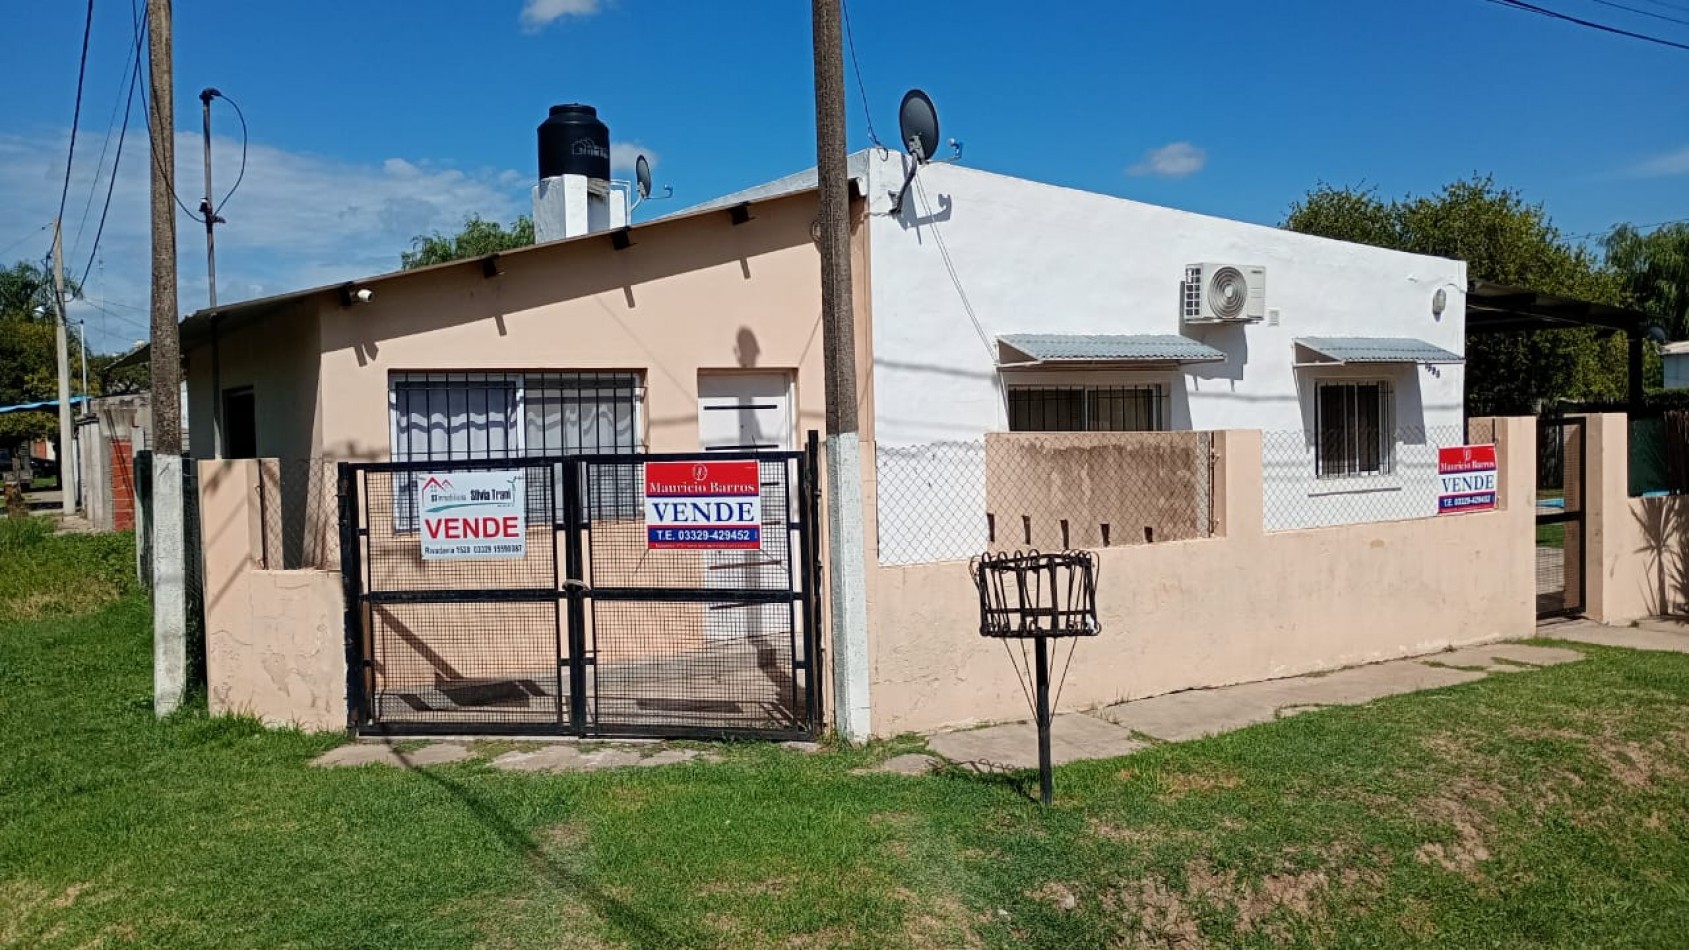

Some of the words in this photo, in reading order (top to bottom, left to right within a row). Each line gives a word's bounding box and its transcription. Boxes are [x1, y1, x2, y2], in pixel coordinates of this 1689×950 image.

[649, 481, 707, 493] Mauricio
[710, 482, 755, 493] Barros
[1441, 474, 1494, 493] VENDE
[652, 502, 755, 522] VENDE
[424, 516, 520, 539] VENDE
[655, 530, 675, 540] T.E.
[678, 529, 750, 540] 03329-429452
